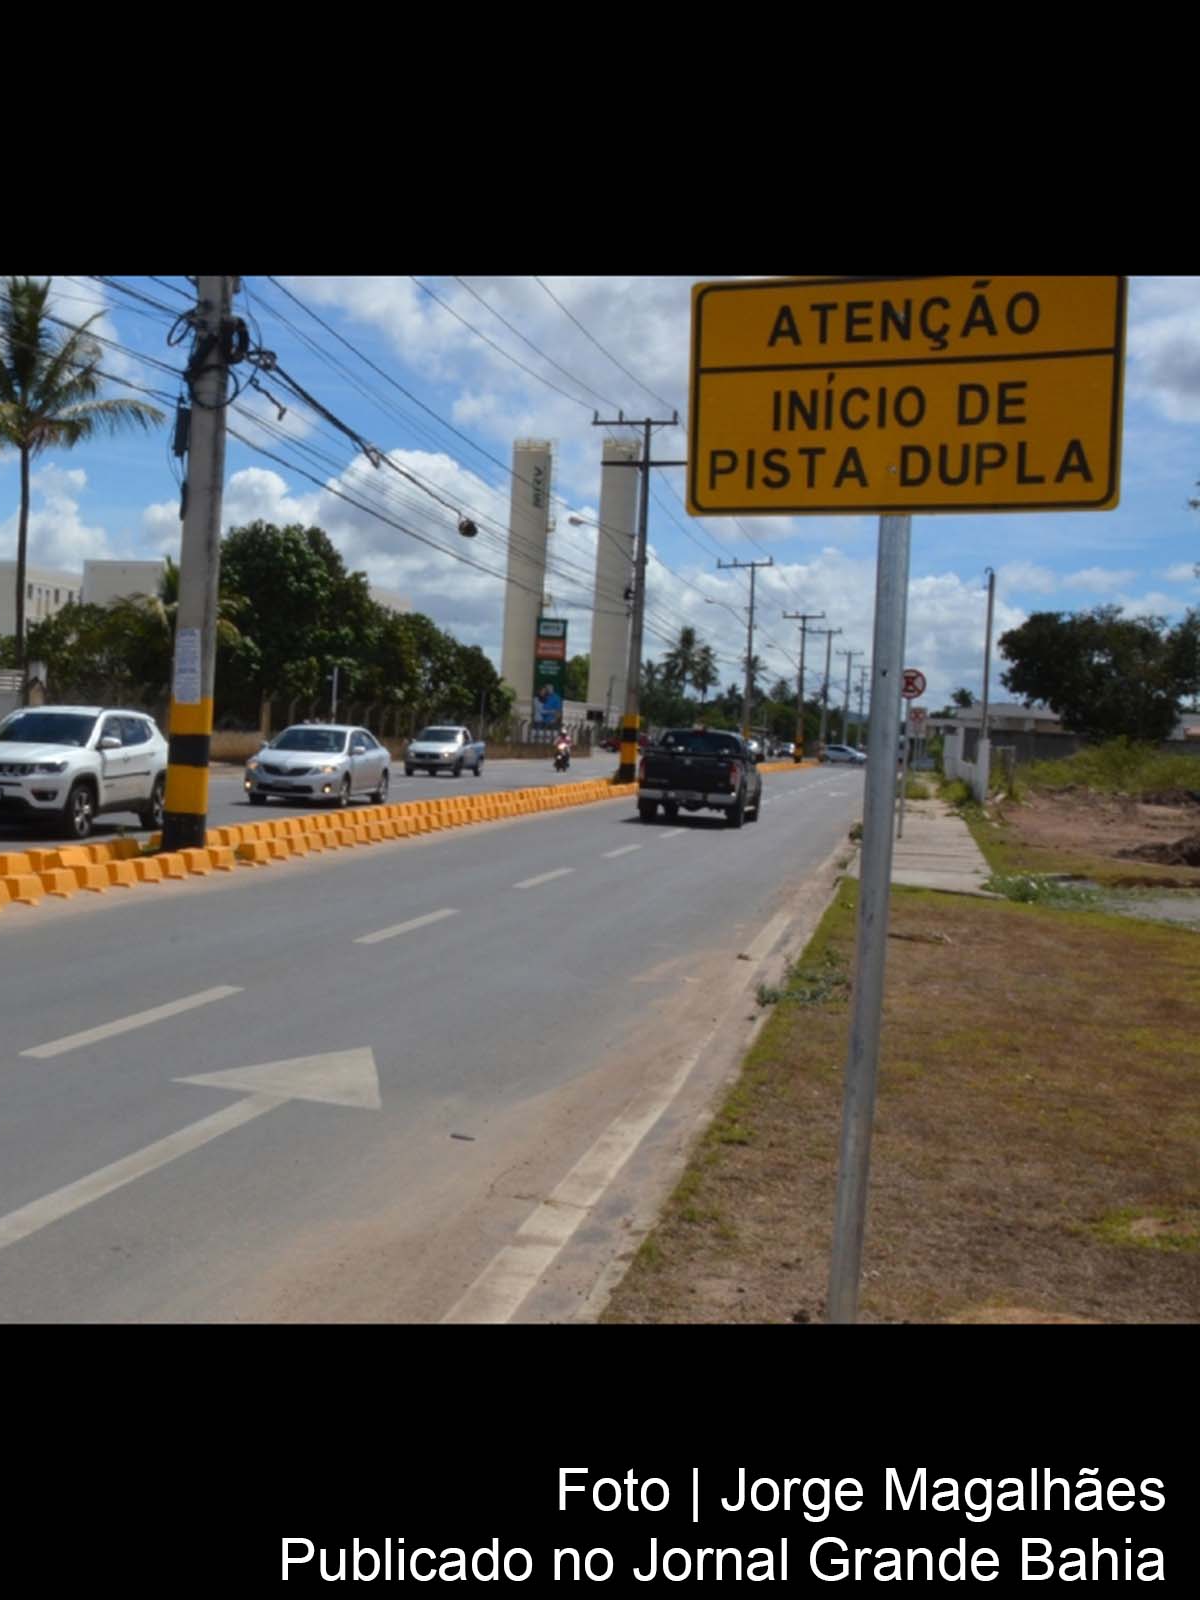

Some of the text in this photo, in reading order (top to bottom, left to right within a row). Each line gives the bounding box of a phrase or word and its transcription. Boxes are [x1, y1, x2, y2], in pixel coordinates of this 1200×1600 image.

[767, 279, 1040, 351] ATENÇÃO
[773, 372, 1028, 432] INÍCIO DE
[709, 439, 1094, 490] PISTA DUPLA
